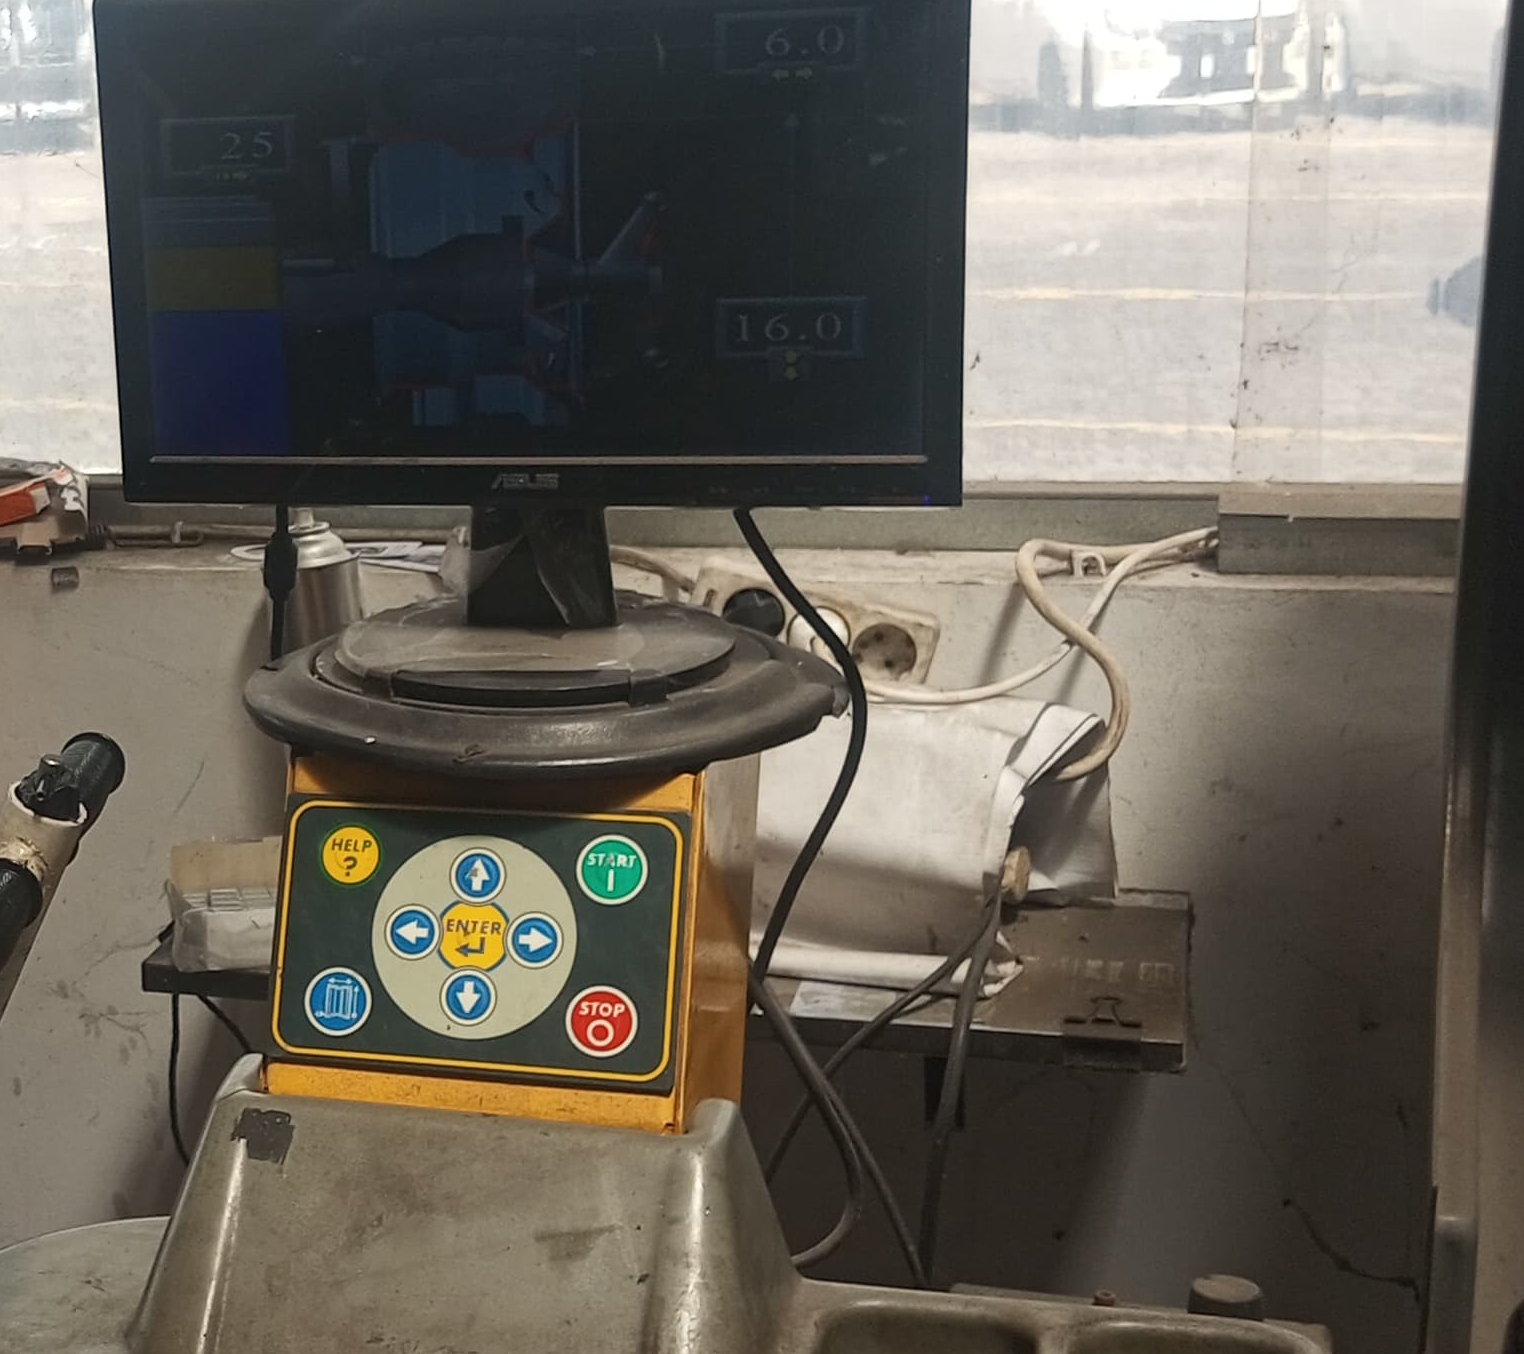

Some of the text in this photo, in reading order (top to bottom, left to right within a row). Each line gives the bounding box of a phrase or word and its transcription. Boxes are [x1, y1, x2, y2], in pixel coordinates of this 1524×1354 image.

[764, 23, 846, 57] 6.0
[219, 130, 274, 162] 25
[734, 312, 843, 343] 16.0
[331, 836, 372, 853] HELP
[587, 851, 637, 870] START
[446, 918, 502, 936] ENTER
[579, 1000, 626, 1019] STOP
